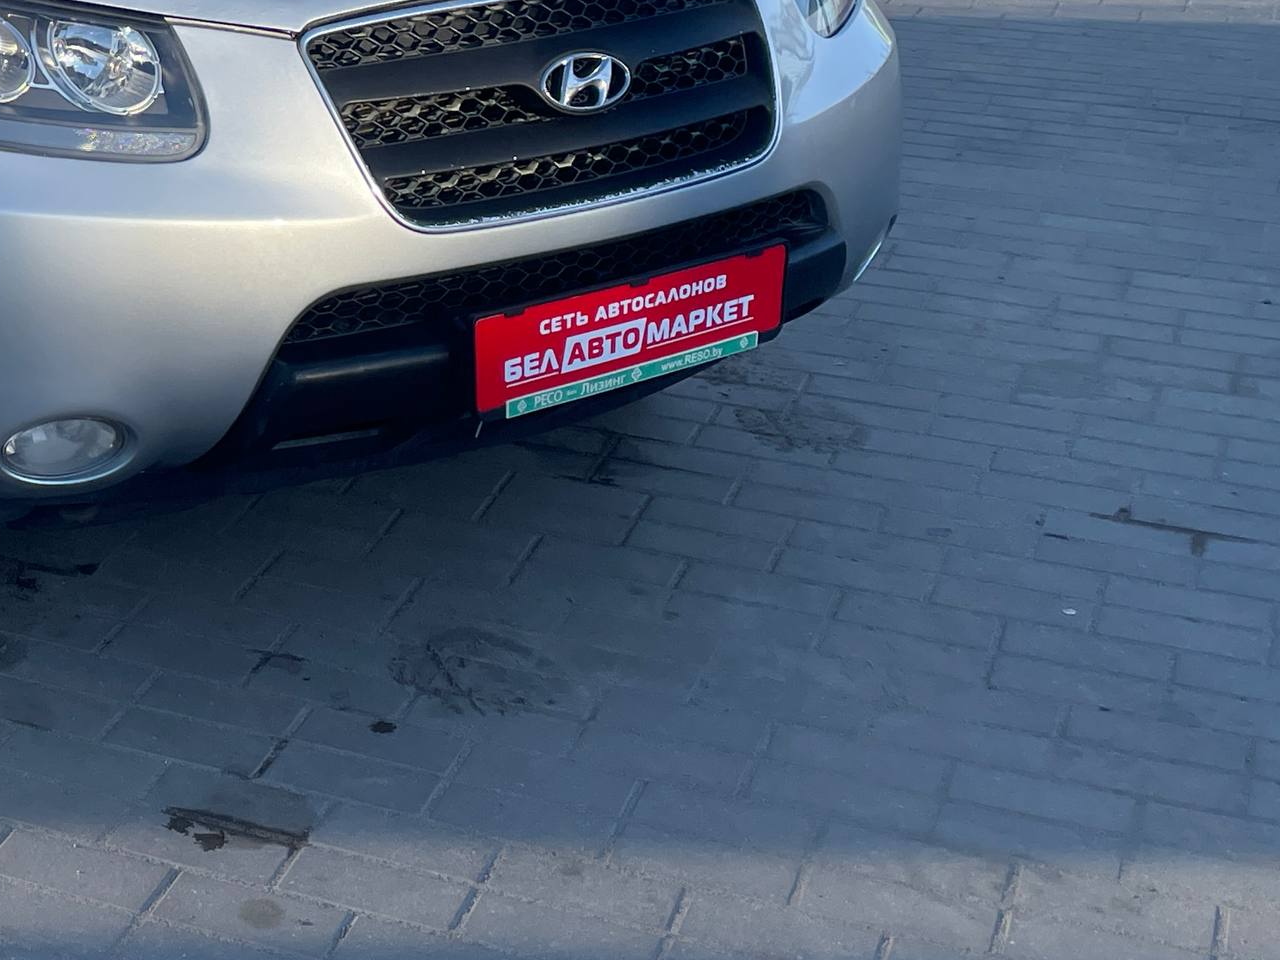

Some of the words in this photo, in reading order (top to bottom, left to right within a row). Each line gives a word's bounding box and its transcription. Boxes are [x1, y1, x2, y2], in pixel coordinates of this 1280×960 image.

[539, 311, 589, 335] СЕТЬ
[594, 274, 728, 322] АВТОСАЛОНОВ
[660, 346, 724, 371] www.RESO.by
[533, 389, 563, 409] РЕСО
[580, 374, 627, 396] Лизинг
